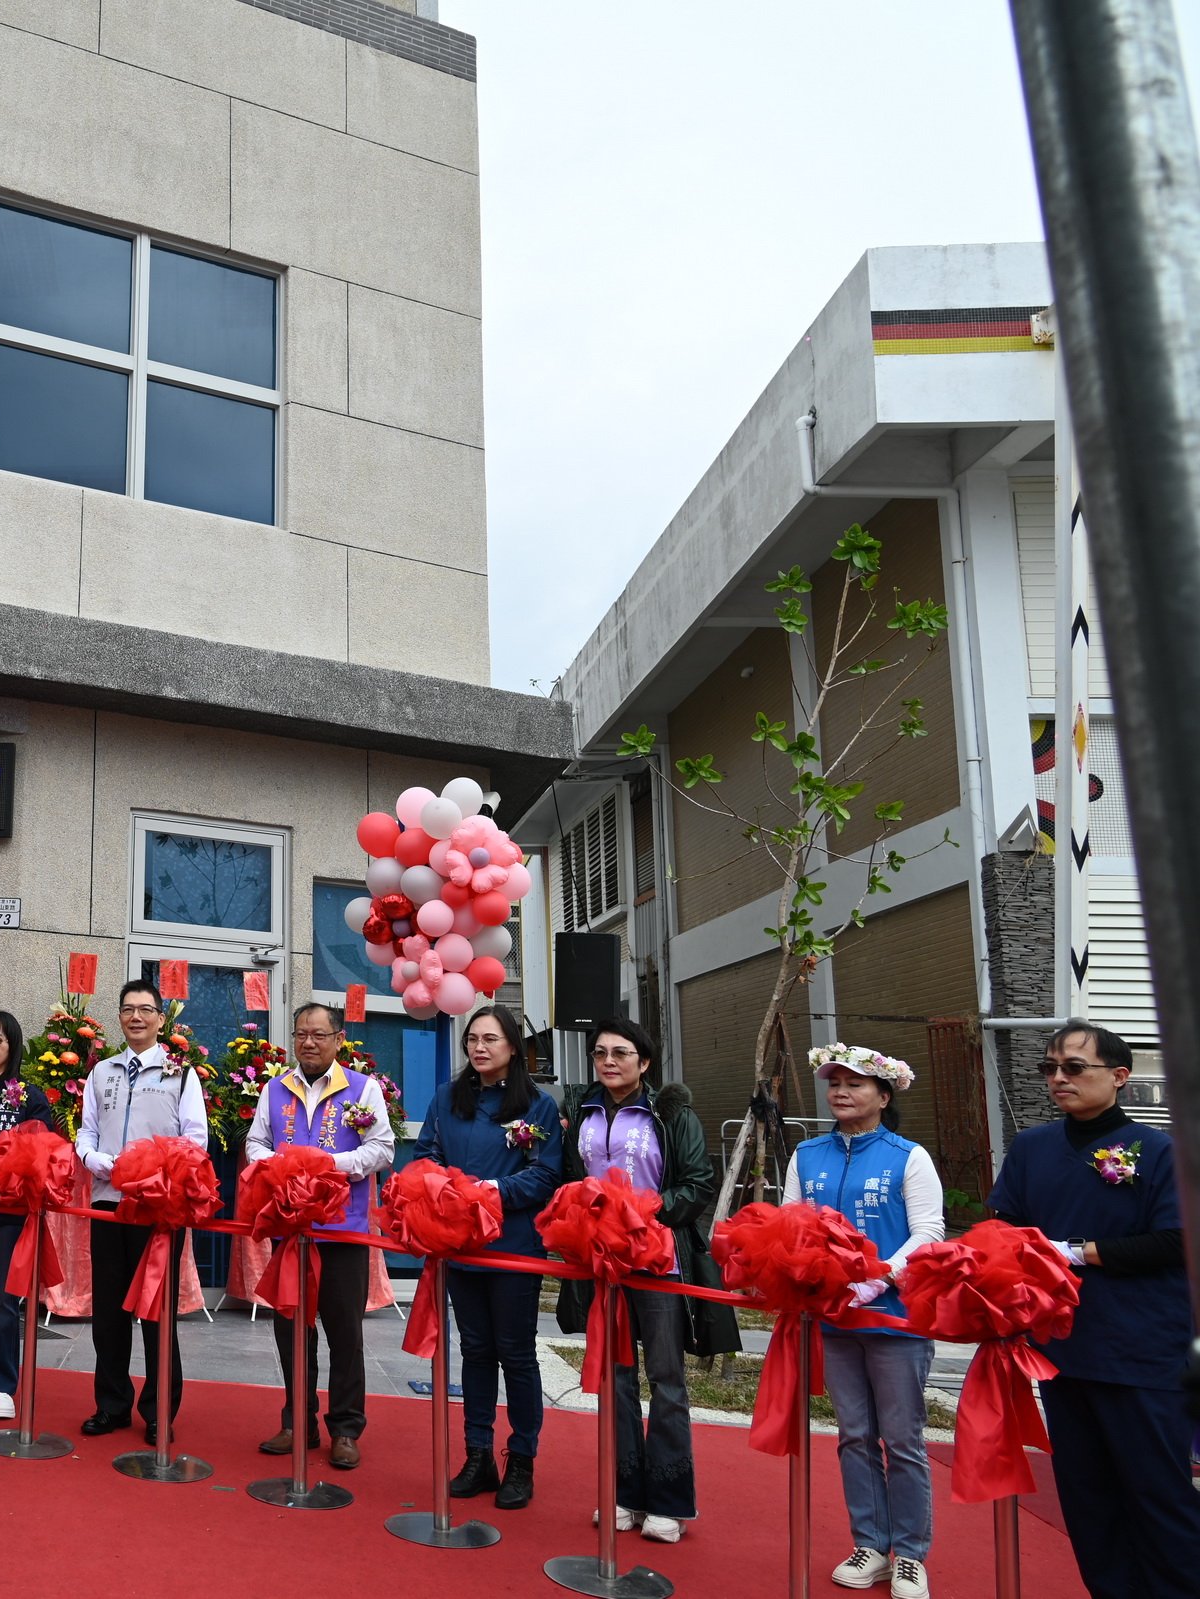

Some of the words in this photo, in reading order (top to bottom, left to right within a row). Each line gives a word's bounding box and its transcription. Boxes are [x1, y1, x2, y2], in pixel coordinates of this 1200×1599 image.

[104, 1076, 115, 1112] 孫國平
[323, 1104, 338, 1150] 古志成
[815, 1172, 828, 1191] 主任
[880, 1169, 892, 1204] 立法委員
